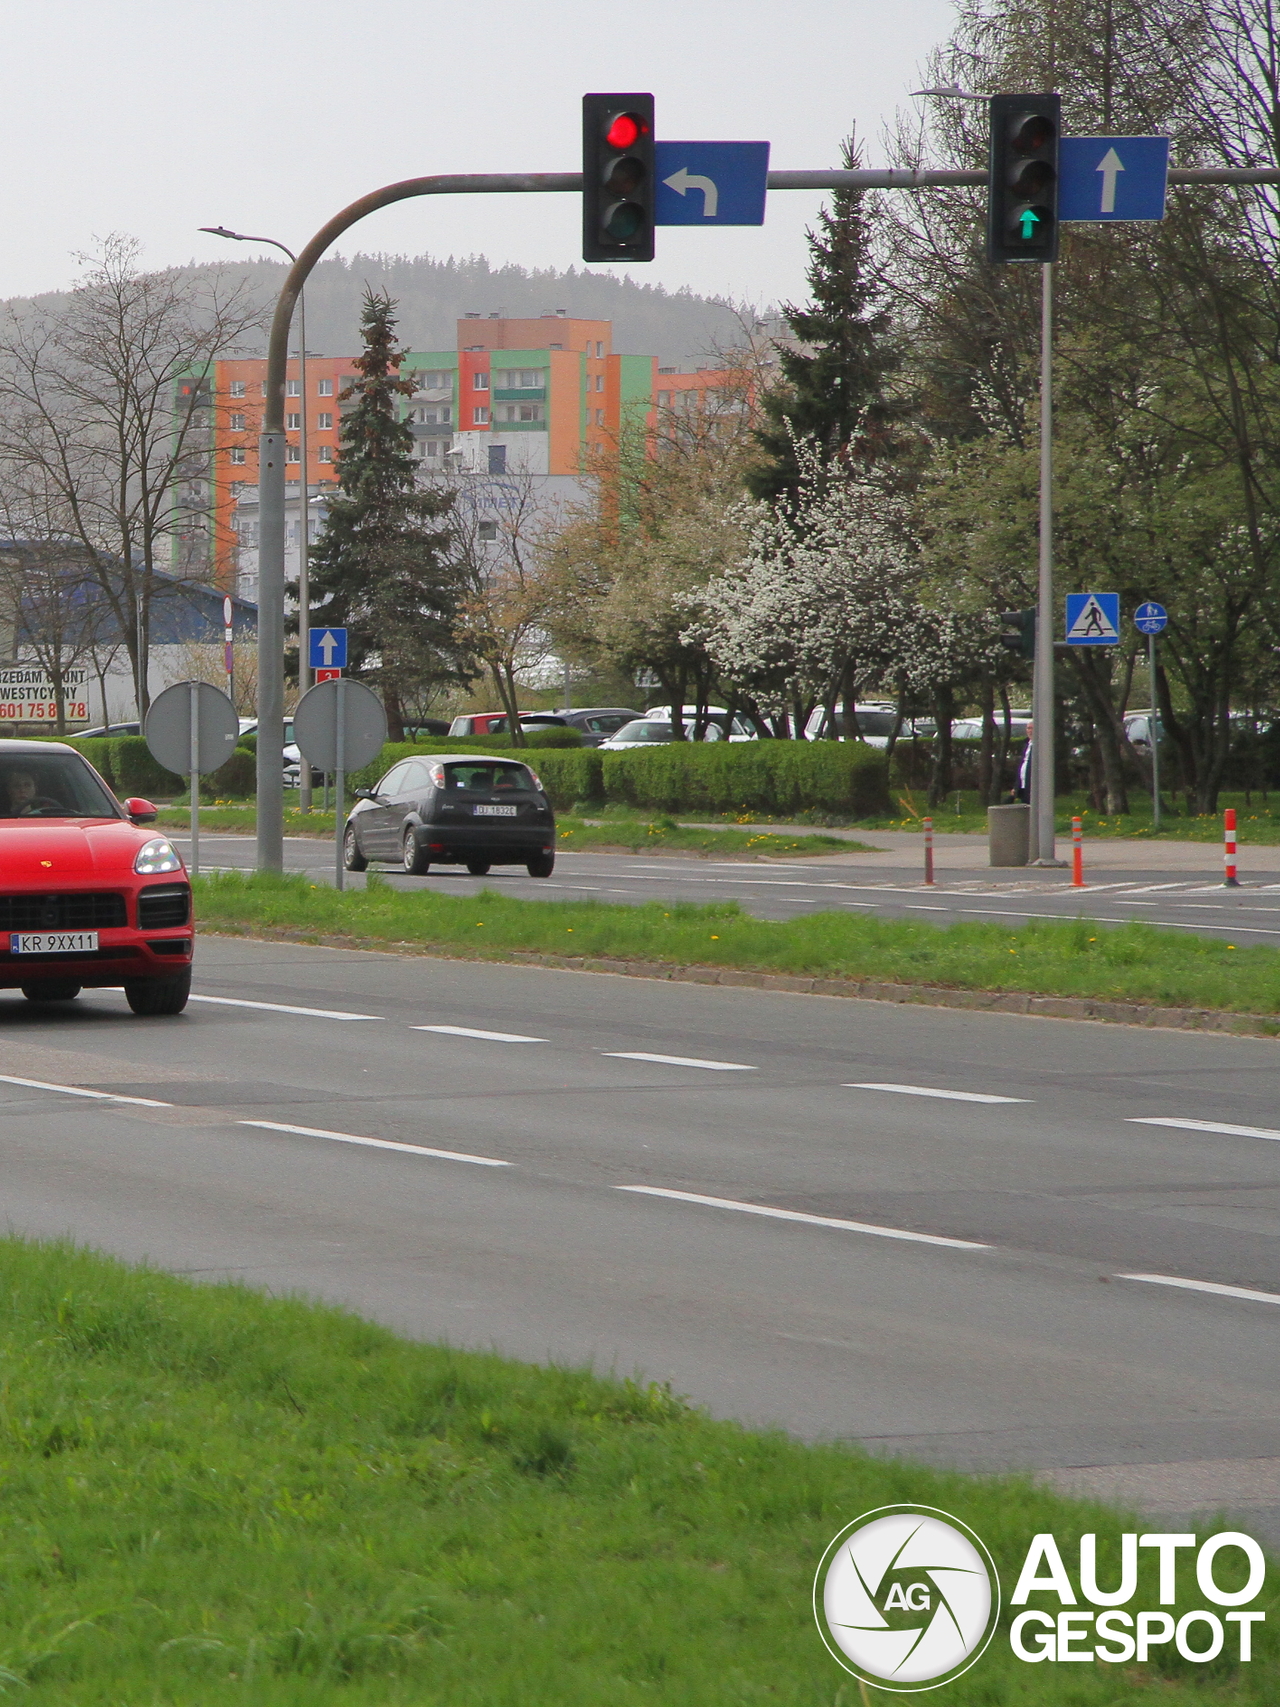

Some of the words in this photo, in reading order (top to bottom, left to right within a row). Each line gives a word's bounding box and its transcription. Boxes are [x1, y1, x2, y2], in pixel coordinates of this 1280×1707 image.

[0, 703, 23, 718] 601
[28, 703, 45, 718] 75
[68, 702, 86, 718] 78
[22, 936, 42, 951] KR
[48, 934, 93, 951] 9XX11
